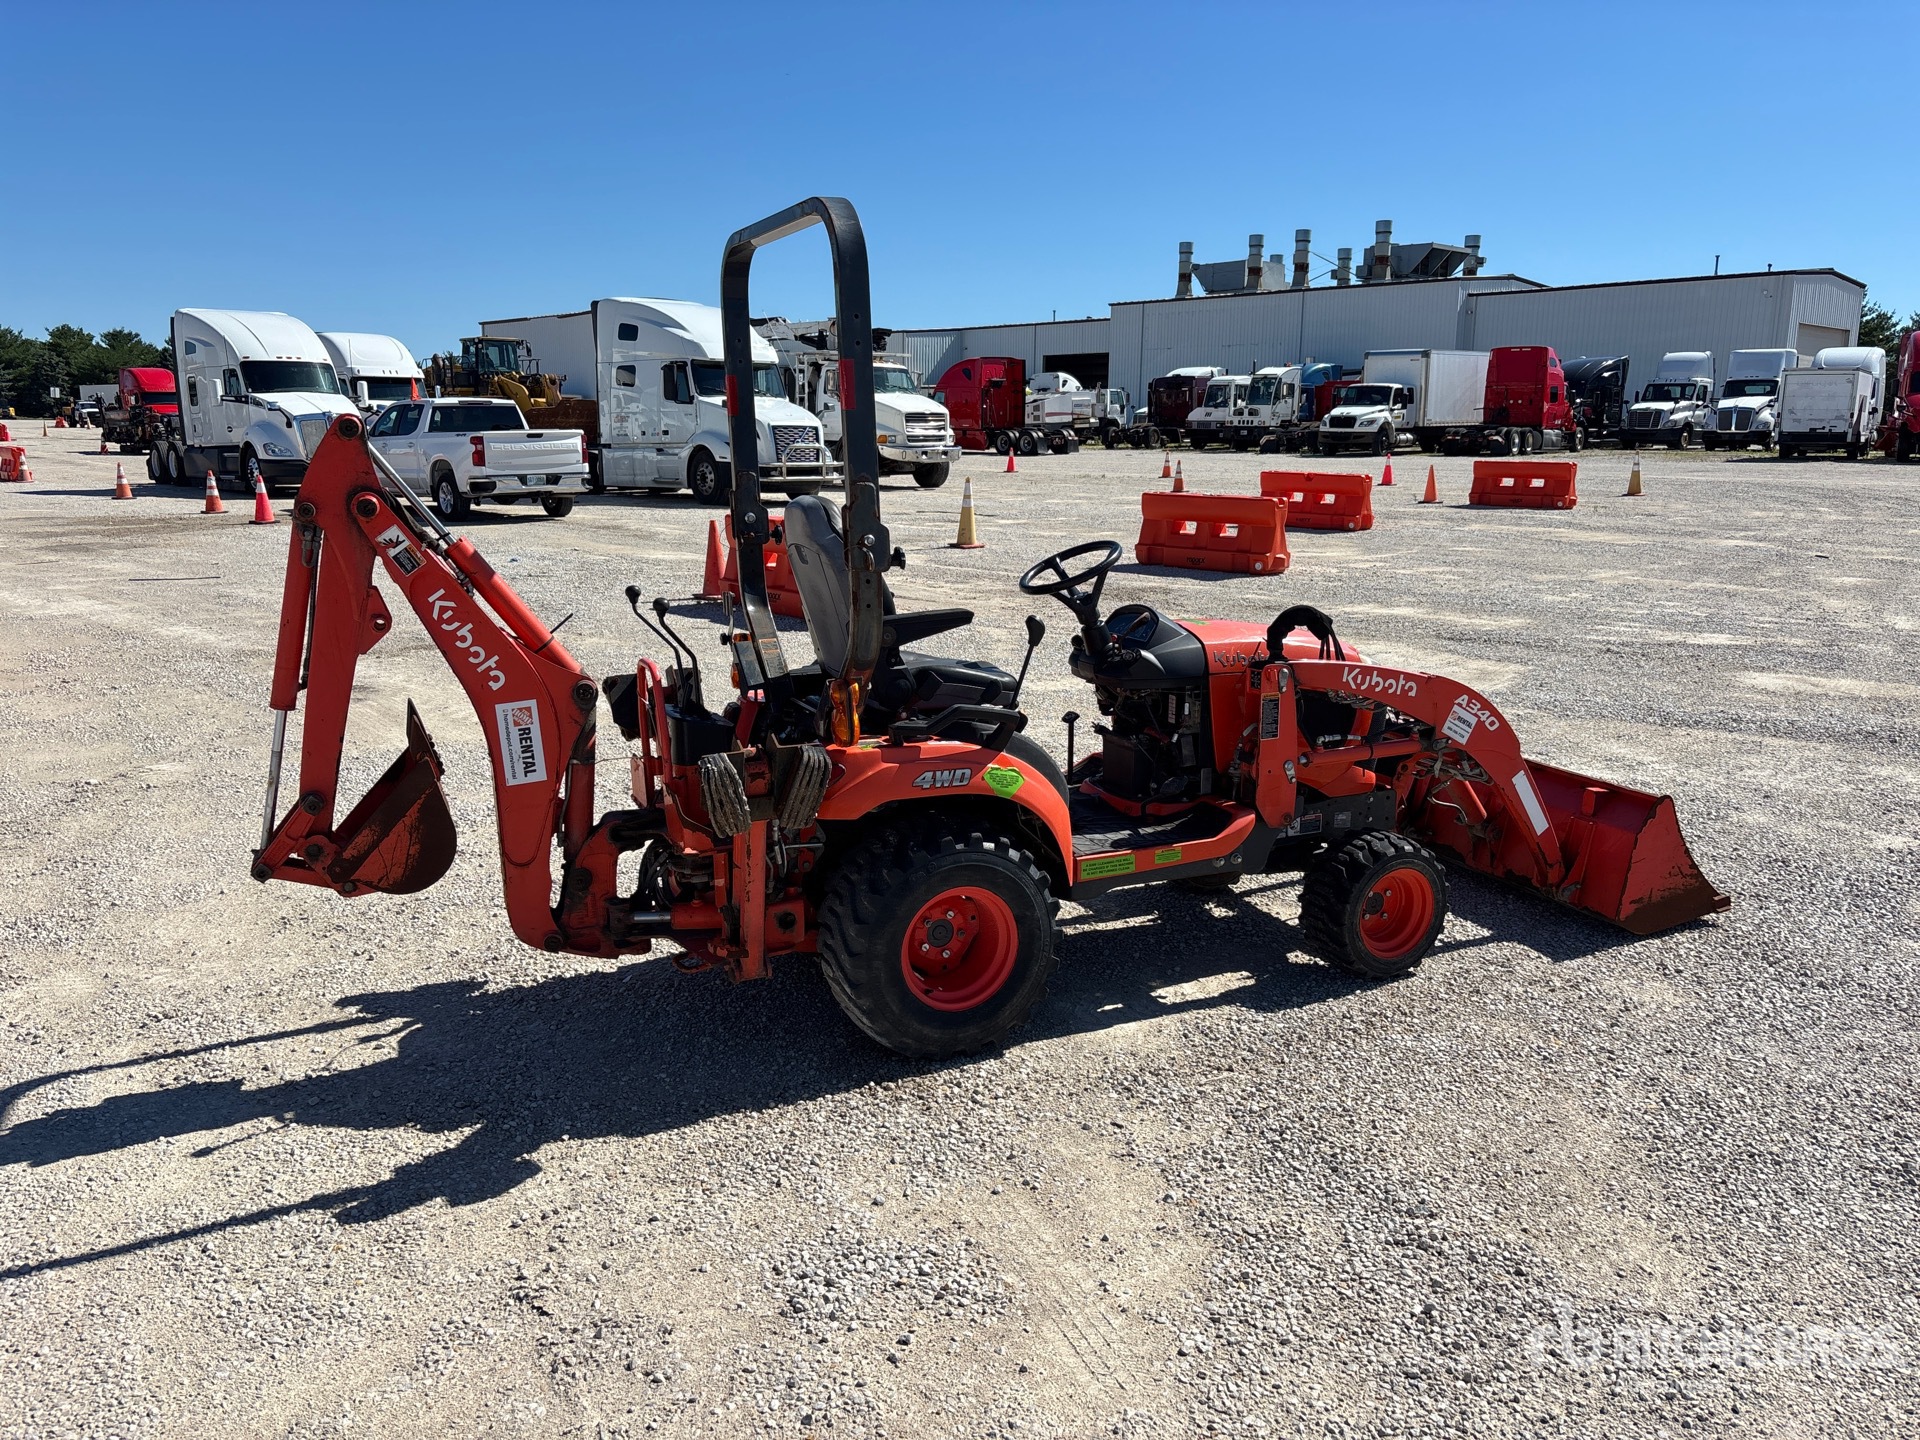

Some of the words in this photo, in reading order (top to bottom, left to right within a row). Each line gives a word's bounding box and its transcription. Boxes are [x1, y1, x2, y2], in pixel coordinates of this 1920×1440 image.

[490, 443, 578, 451] CHEVROLET
[427, 588, 506, 691] Kubota
[1342, 666, 1417, 697] Kubota
[1454, 694, 1500, 731] A340
[1456, 715, 1473, 730] RENTAL
[503, 713, 518, 780] homedepot.com/rental
[517, 726, 537, 778] RENTAL
[912, 768, 972, 789] 4WD
